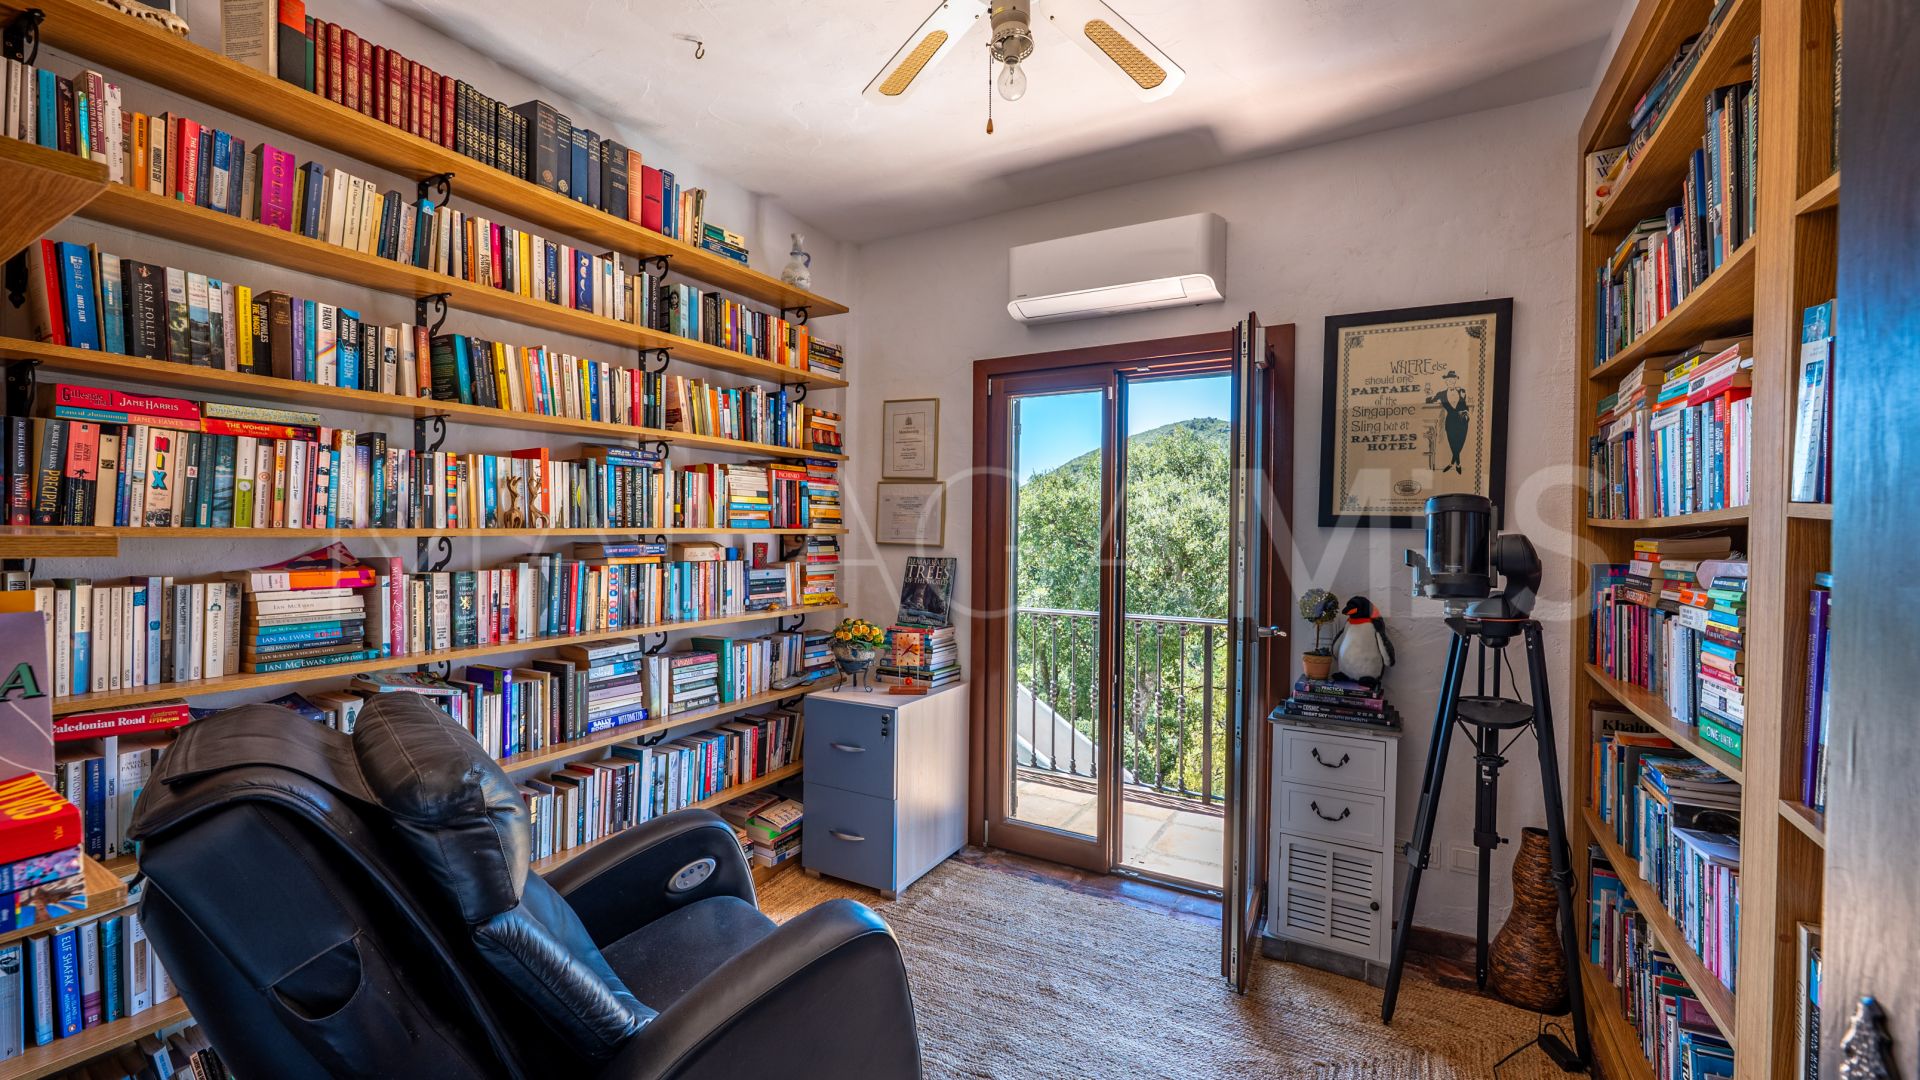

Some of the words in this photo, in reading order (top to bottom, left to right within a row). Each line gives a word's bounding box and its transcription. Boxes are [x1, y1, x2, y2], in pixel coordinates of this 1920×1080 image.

[144, 283, 153, 302] KEN
[76, 294, 85, 309] JAMES
[78, 310, 86, 323] FLINT
[259, 304, 268, 319] JOHN
[322, 306, 333, 330] FRANZEN
[145, 307, 156, 349] FOLLETT
[252, 315, 261, 336] MAGUS
[260, 319, 269, 343] FOWLES
[341, 318, 349, 341] FRANZEN
[348, 318, 356, 344] JONATHAN
[367, 326, 376, 335] THE
[367, 335, 376, 356] WOMEN'S
[343, 345, 355, 379] FREEDOM
[367, 356, 376, 370] ROOM
[1390, 358, 1434, 376] WHERE
[1432, 361, 1447, 371] else
[1365, 375, 1395, 386] should
[1396, 375, 1414, 384] one
[62, 386, 105, 402] Gillespie
[1350, 384, 1421, 396] PARTAKE
[119, 397, 145, 408] JANE
[145, 400, 179, 411] HARRIS
[1374, 395, 1384, 406] of
[1386, 396, 1397, 406] the
[1352, 405, 1416, 419] Singapore
[133, 416, 156, 425] JAMES
[158, 418, 184, 427] HAWES
[225, 422, 241, 430] THE
[242, 423, 271, 432] WOMEN
[1351, 420, 1381, 432] Sling
[1400, 421, 1409, 431] at
[17, 421, 25, 444] ROBERT
[51, 424, 61, 447] ROBERT
[1351, 433, 1417, 443] RAFFLES
[1367, 442, 1417, 451] HOTEL
[17, 445, 25, 468] HARRIS
[49, 447, 59, 470] HARRIS
[151, 436, 171, 491] NIX
[331, 460, 339, 477] NICK
[14, 473, 30, 508] POMPEII
[40, 469, 61, 512] PRECIPICE
[76, 489, 84, 510] CLOSING
[75, 510, 84, 524] TIME
[907, 564, 949, 580] TREES
[232, 601, 240, 618] FRANK
[231, 620, 239, 647] McCOURT
[262, 636, 278, 644] IAN
[278, 632, 311, 641] McEWAN
[264, 663, 282, 672] IAN
[285, 658, 326, 669] McEWAN
[331, 654, 361, 663] SATURDAY
[1, 662, 47, 700] A
[1302, 704, 1320, 712] COSMIC
[117, 715, 146, 726] Road
[590, 722, 616, 732] ROONEY
[593, 717, 612, 727] SALLY
[618, 711, 644, 725] INTERMEZZO
[121, 762, 149, 772] PAMUK
[61, 935, 72, 952] ELIF
[62, 955, 74, 986] SHAFAK
